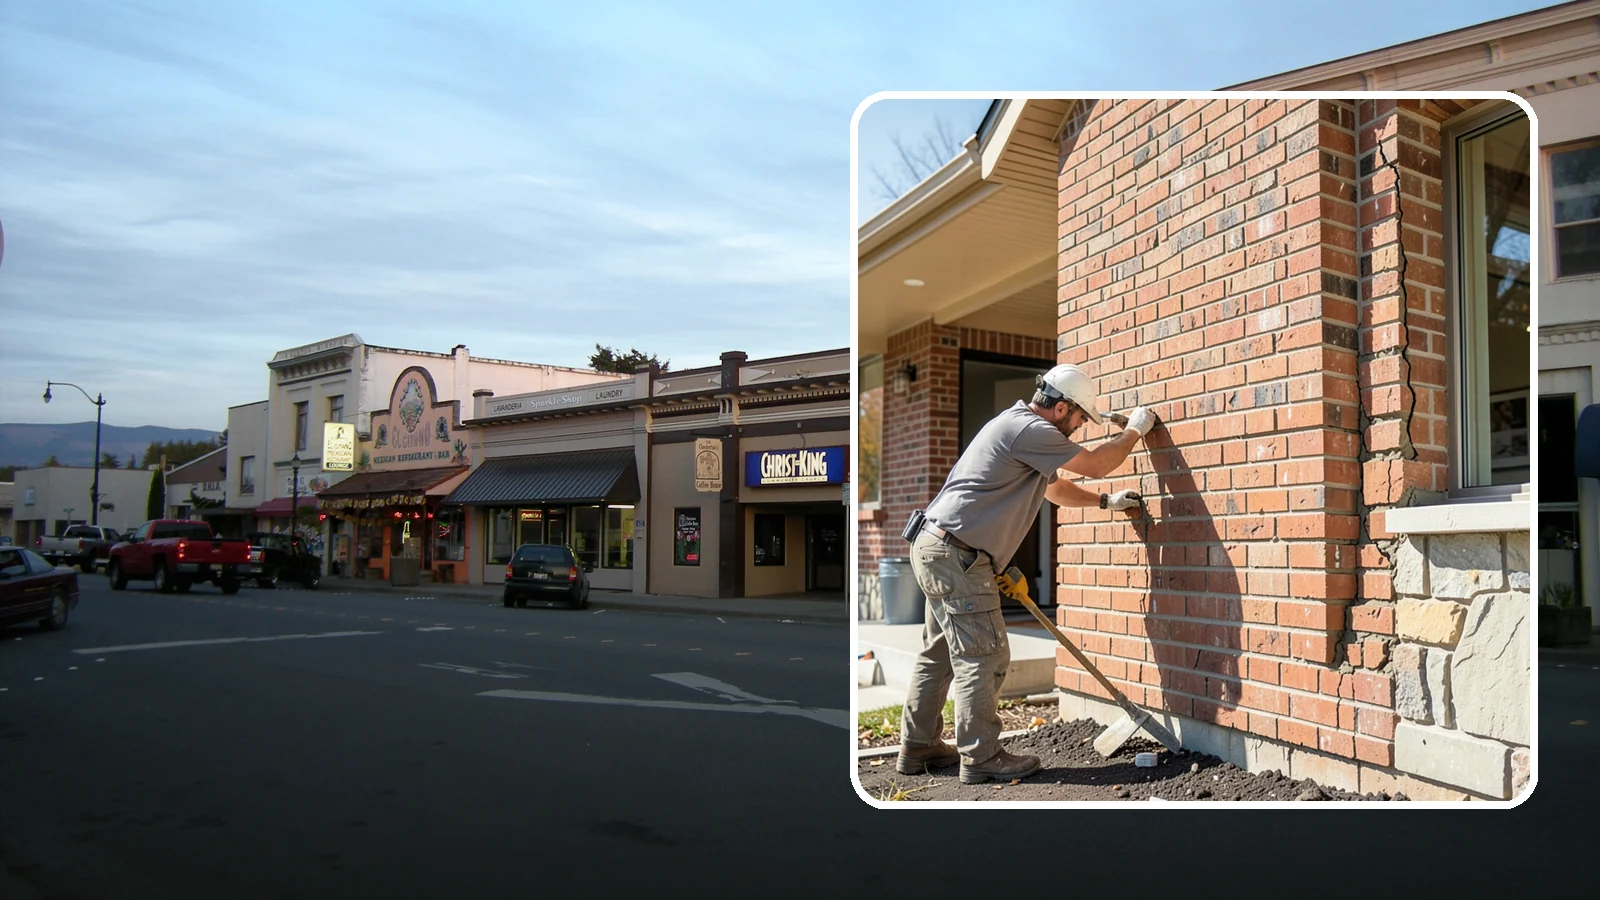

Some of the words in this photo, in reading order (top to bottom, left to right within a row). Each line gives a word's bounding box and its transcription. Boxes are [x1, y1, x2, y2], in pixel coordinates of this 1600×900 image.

[562, 394, 583, 404] Shop
[595, 389, 624, 400] LAUNDRY
[493, 402, 523, 412] LAVANDERIA
[327, 449, 352, 457] MEXICAN
[373, 454, 396, 464] MEXICAN
[397, 451, 434, 462] RESTAURANT
[437, 450, 450, 459] BAR
[760, 452, 797, 478] CHRIST
[799, 449, 828, 476] KING
[696, 480, 709, 489] Coffee
[710, 480, 722, 489] House
